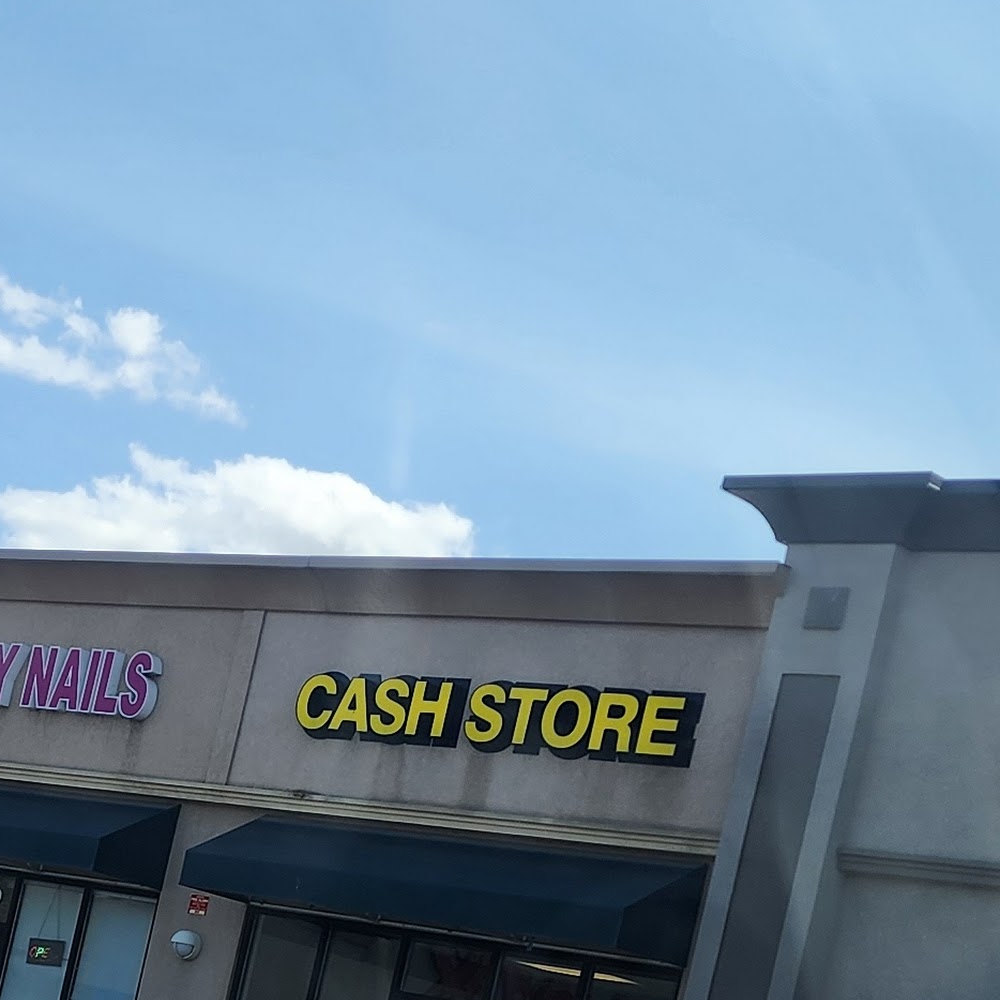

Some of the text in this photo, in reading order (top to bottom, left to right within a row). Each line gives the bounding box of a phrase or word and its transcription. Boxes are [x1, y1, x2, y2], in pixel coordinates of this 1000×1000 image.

[19, 645, 157, 720] NAILS
[295, 673, 692, 760] CASH STORE
